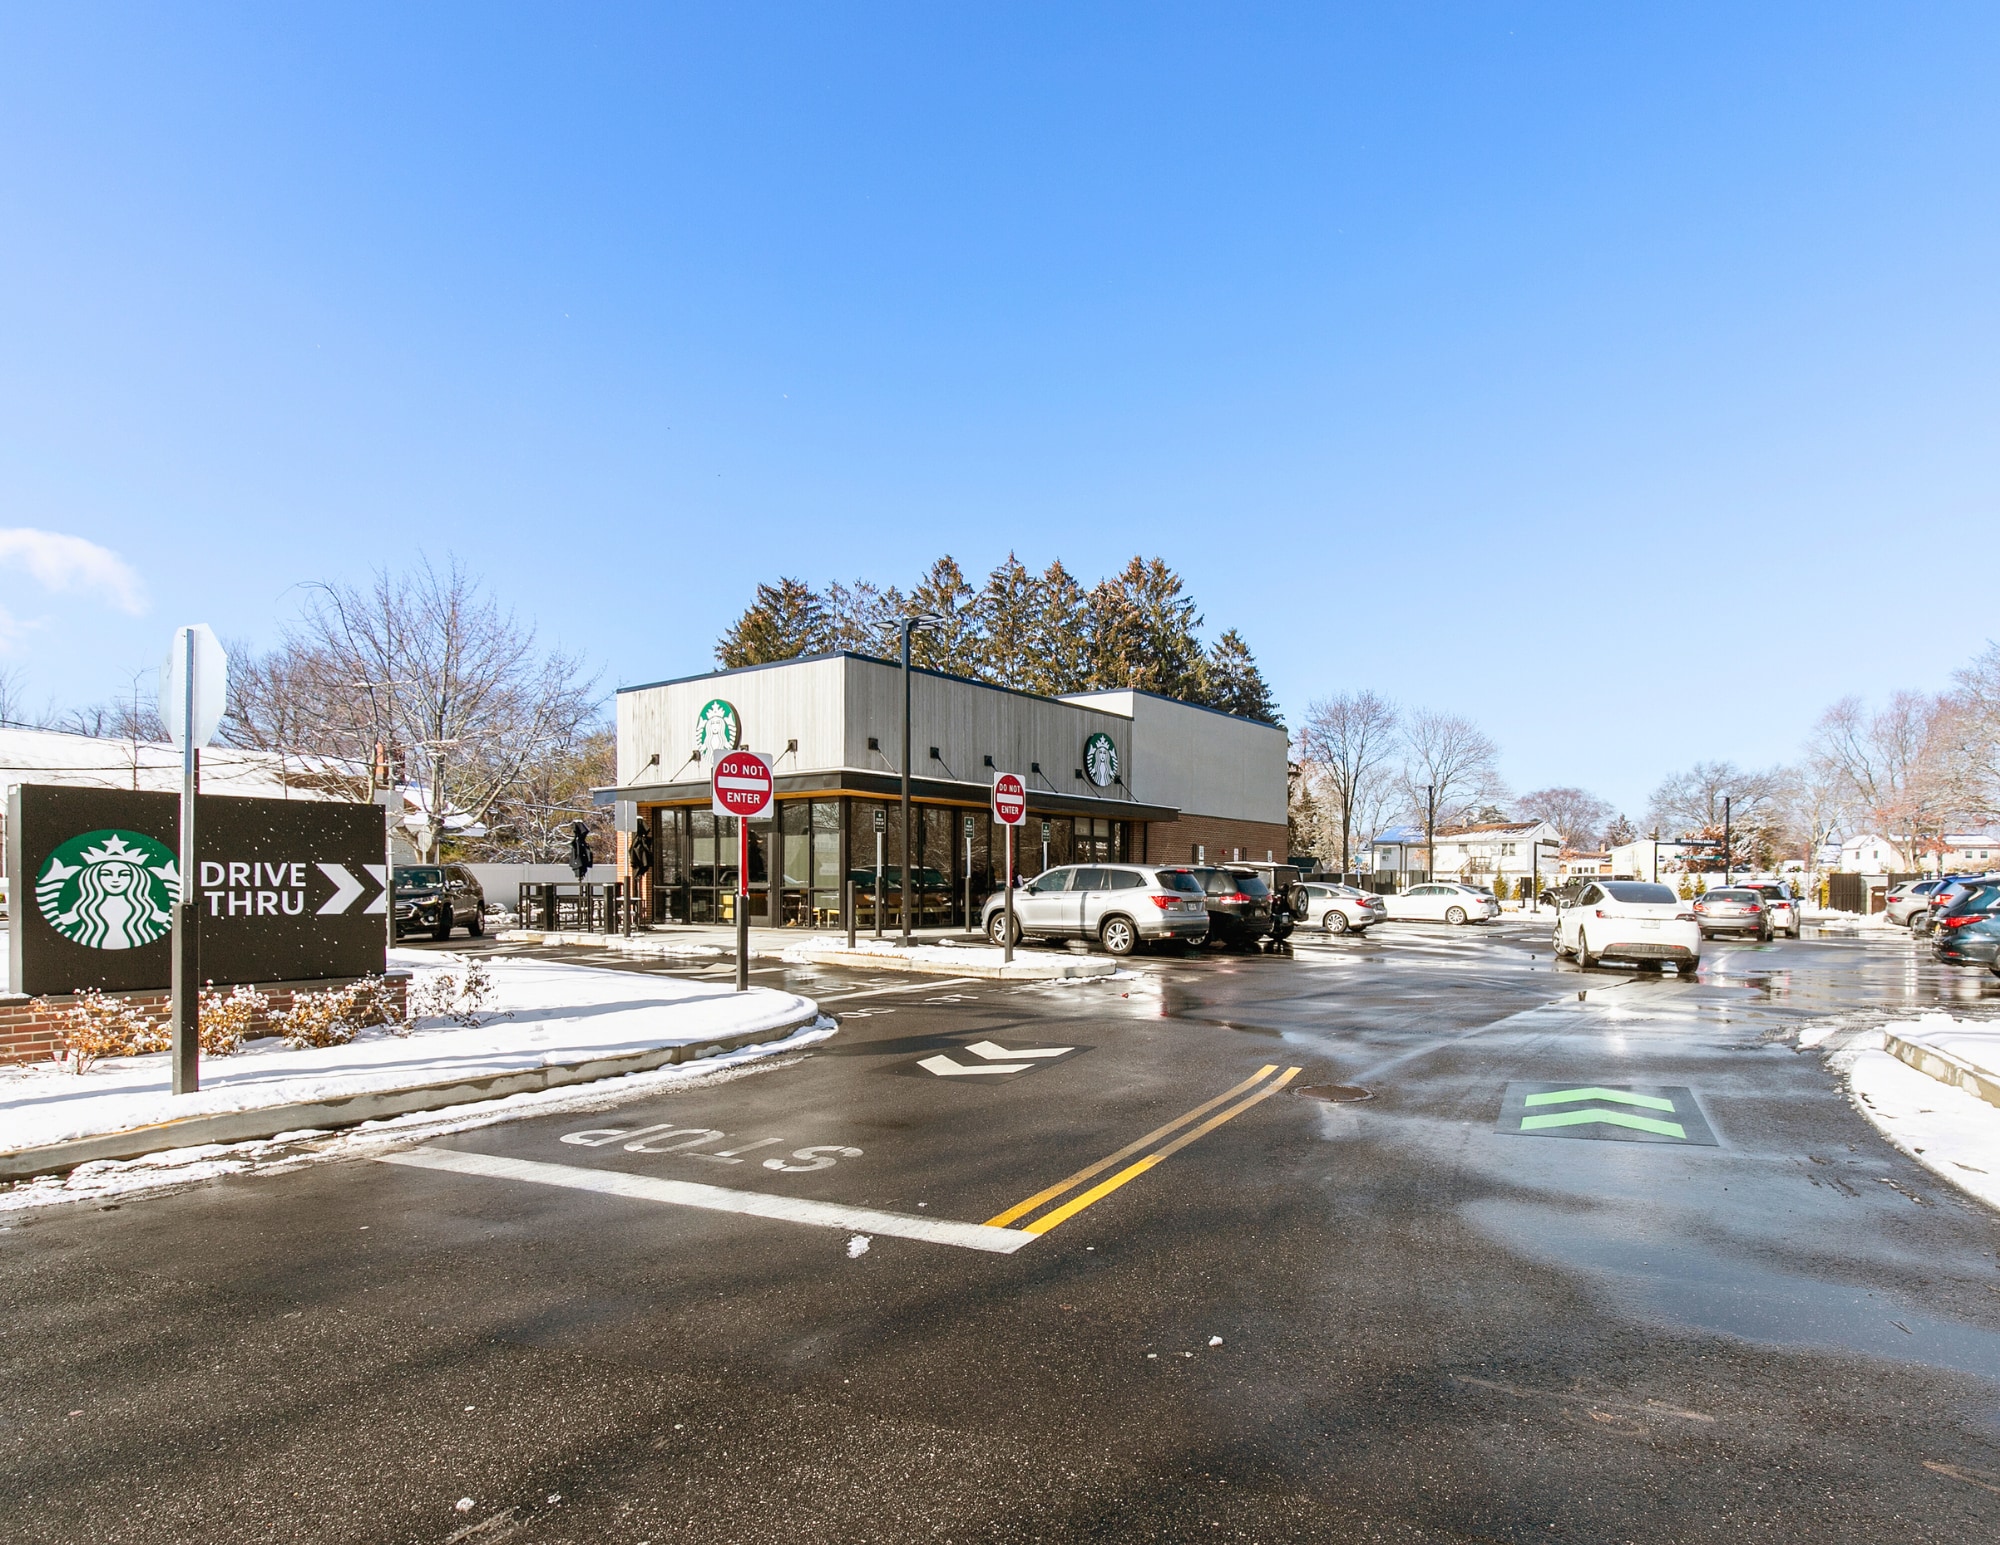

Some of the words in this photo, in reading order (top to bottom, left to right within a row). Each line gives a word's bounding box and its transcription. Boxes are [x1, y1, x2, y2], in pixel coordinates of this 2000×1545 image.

[722, 762, 738, 775] DO
[742, 764, 764, 777] NOT
[999, 783, 1007, 792] DO
[1009, 785, 1020, 793] NOT
[726, 791, 760, 804] ENTER
[1001, 805, 1018, 815] ENTER
[200, 861, 307, 887] DRIVE
[203, 890, 304, 917] THRU
[559, 1123, 865, 1172] STOP
